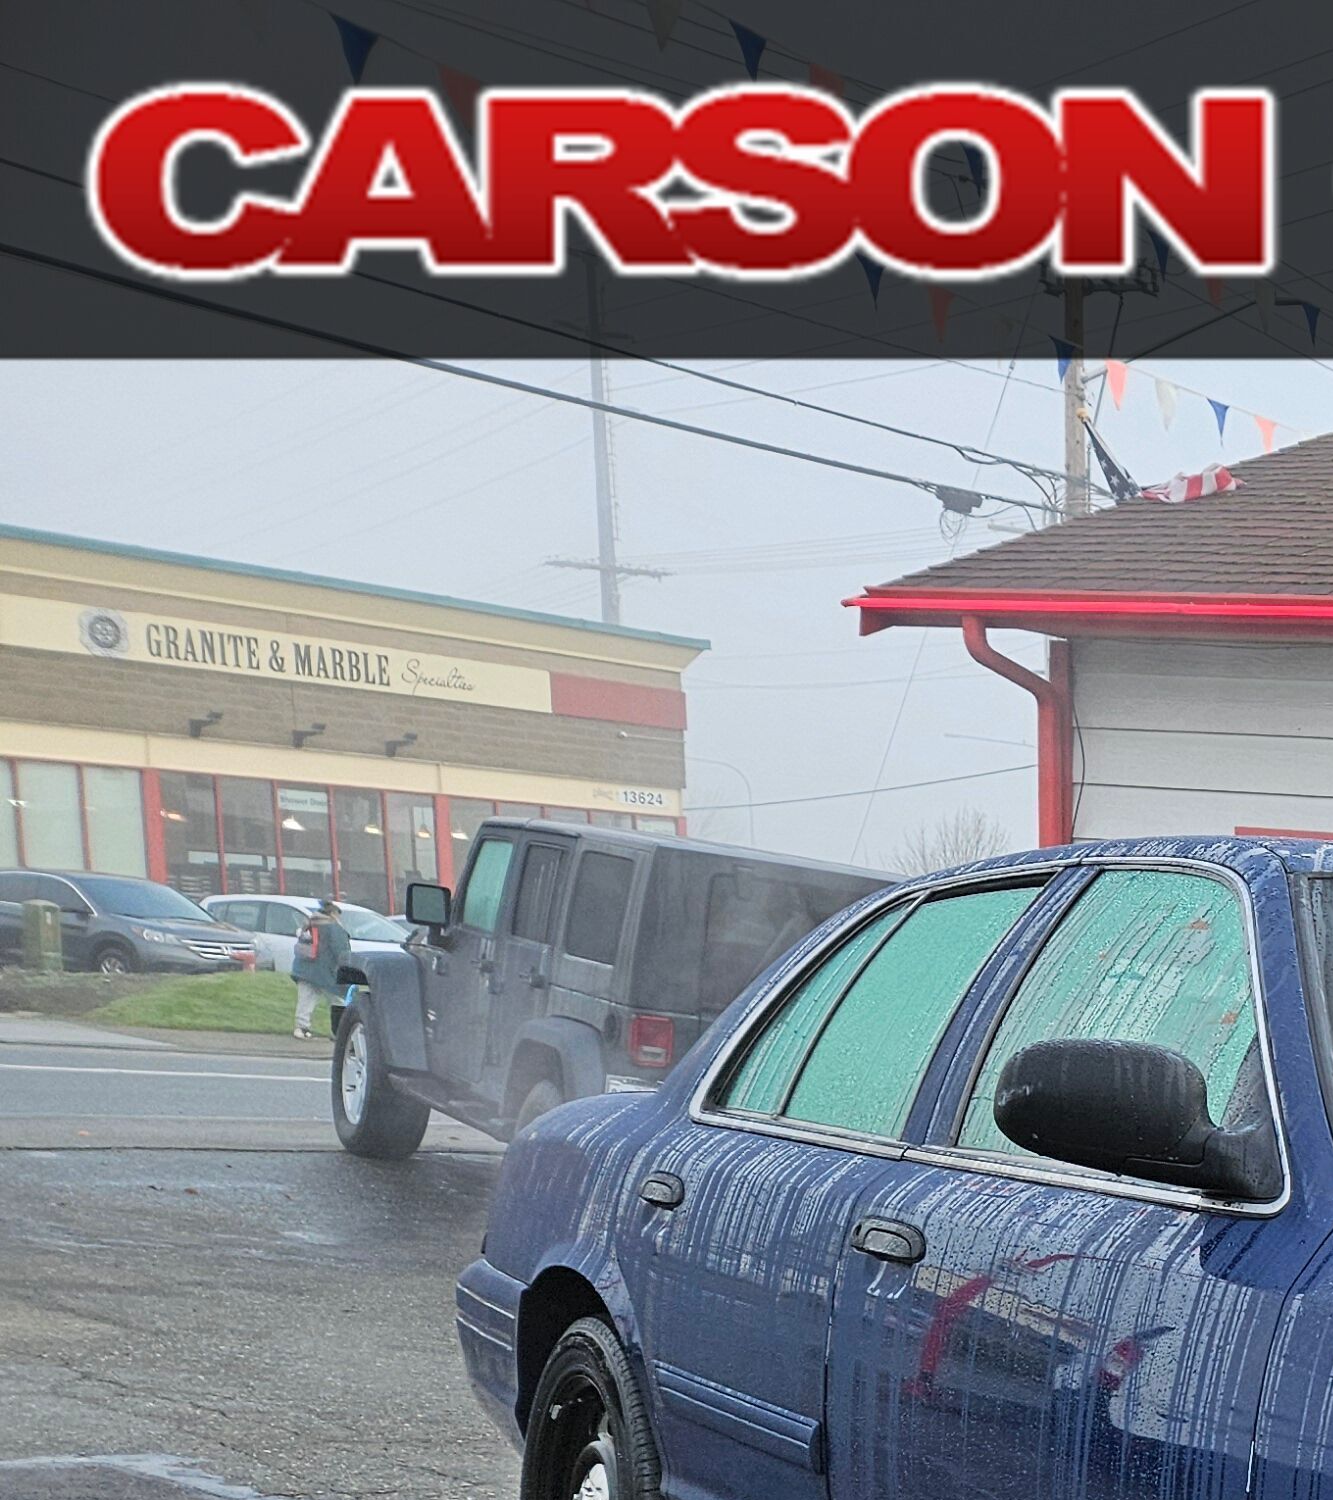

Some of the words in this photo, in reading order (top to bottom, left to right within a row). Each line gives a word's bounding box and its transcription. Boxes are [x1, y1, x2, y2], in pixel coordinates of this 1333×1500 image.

[146, 623, 260, 670] GRANITE
[269, 639, 286, 673] &
[293, 642, 391, 687] MARBLE
[401, 658, 475, 695] Specialties
[623, 790, 664, 805] 13624
